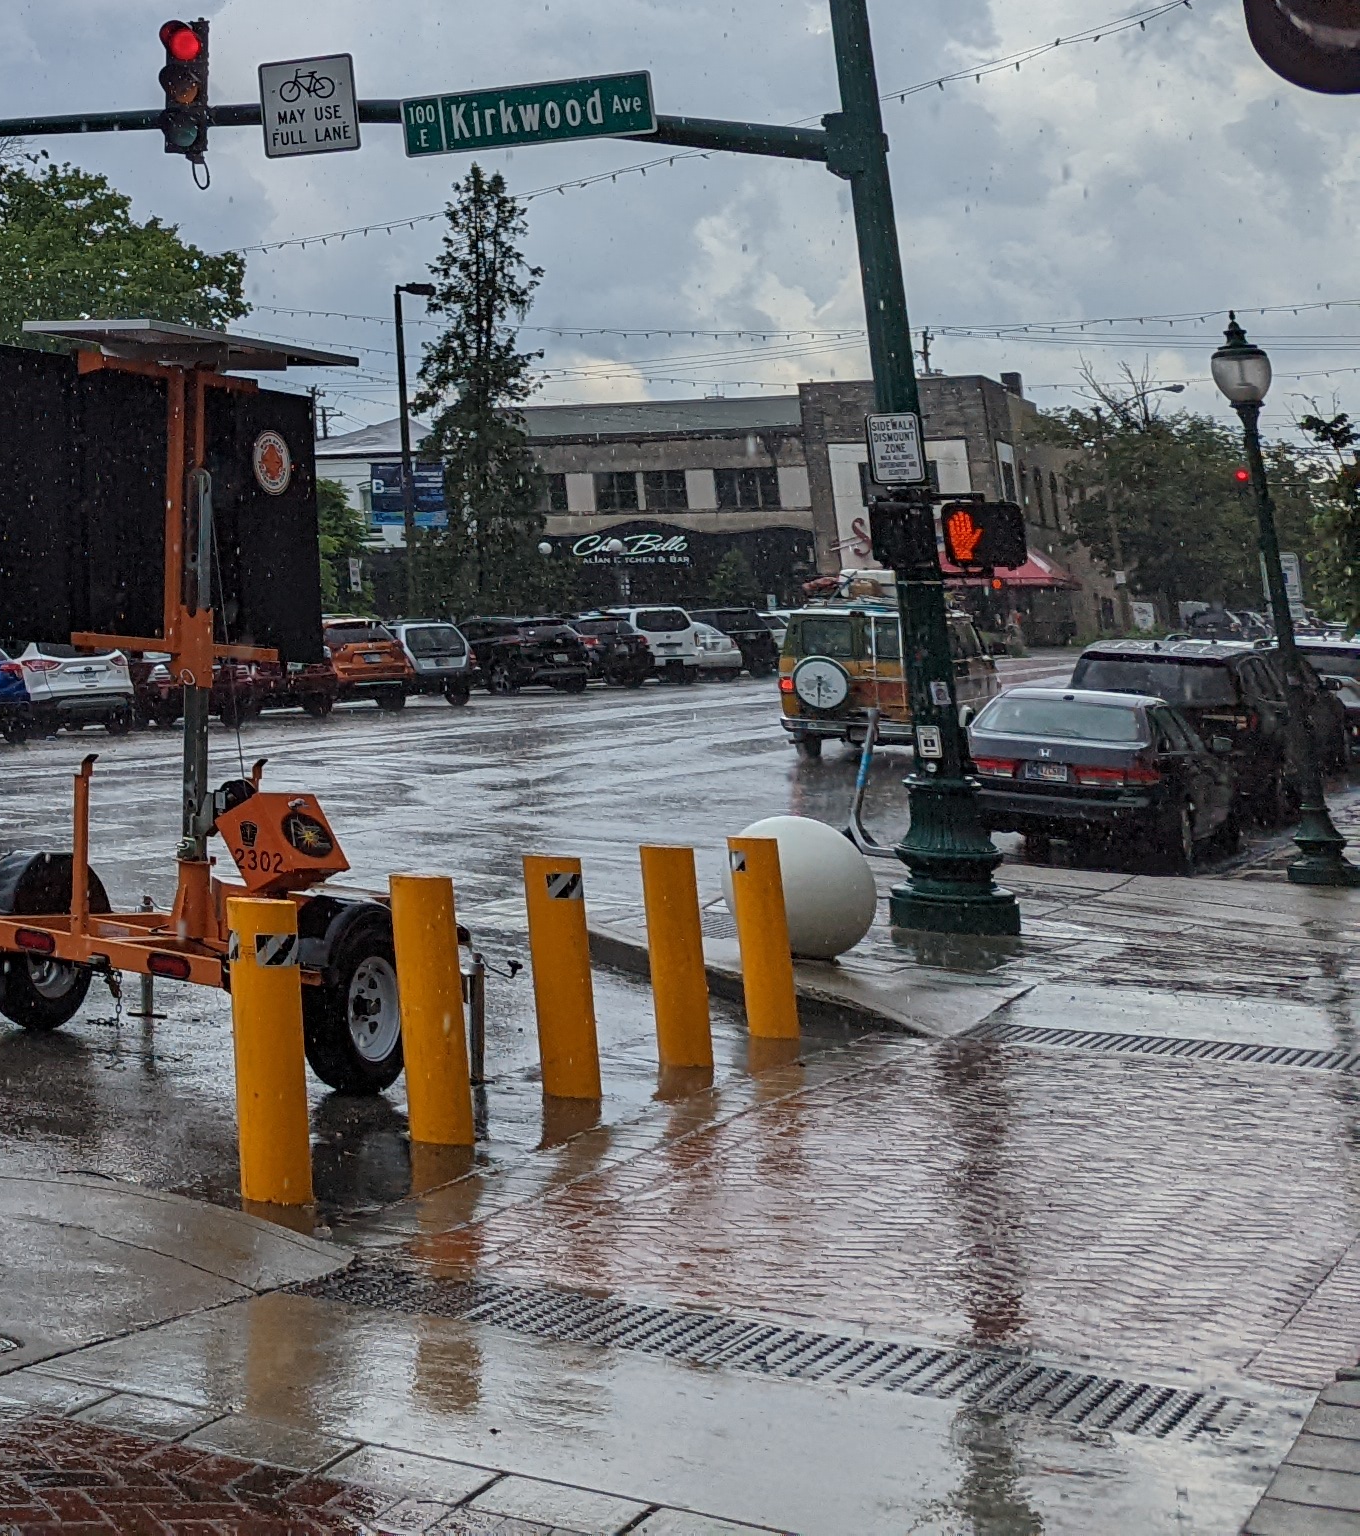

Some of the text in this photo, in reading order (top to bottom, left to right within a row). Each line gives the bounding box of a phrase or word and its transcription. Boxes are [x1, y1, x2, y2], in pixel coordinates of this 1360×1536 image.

[278, 104, 342, 125] MAY USE
[408, 104, 436, 125] 100
[450, 87, 643, 140] Kirkwood Ave
[272, 124, 352, 147] FULL LANE
[420, 128, 431, 148] E
[871, 419, 915, 432] SIDEWALK
[873, 431, 915, 443] DISMOUNT
[884, 443, 907, 454] ZONE
[620, 533, 688, 555] Bello
[669, 555, 690, 564] BAR
[234, 848, 284, 874] 2302
